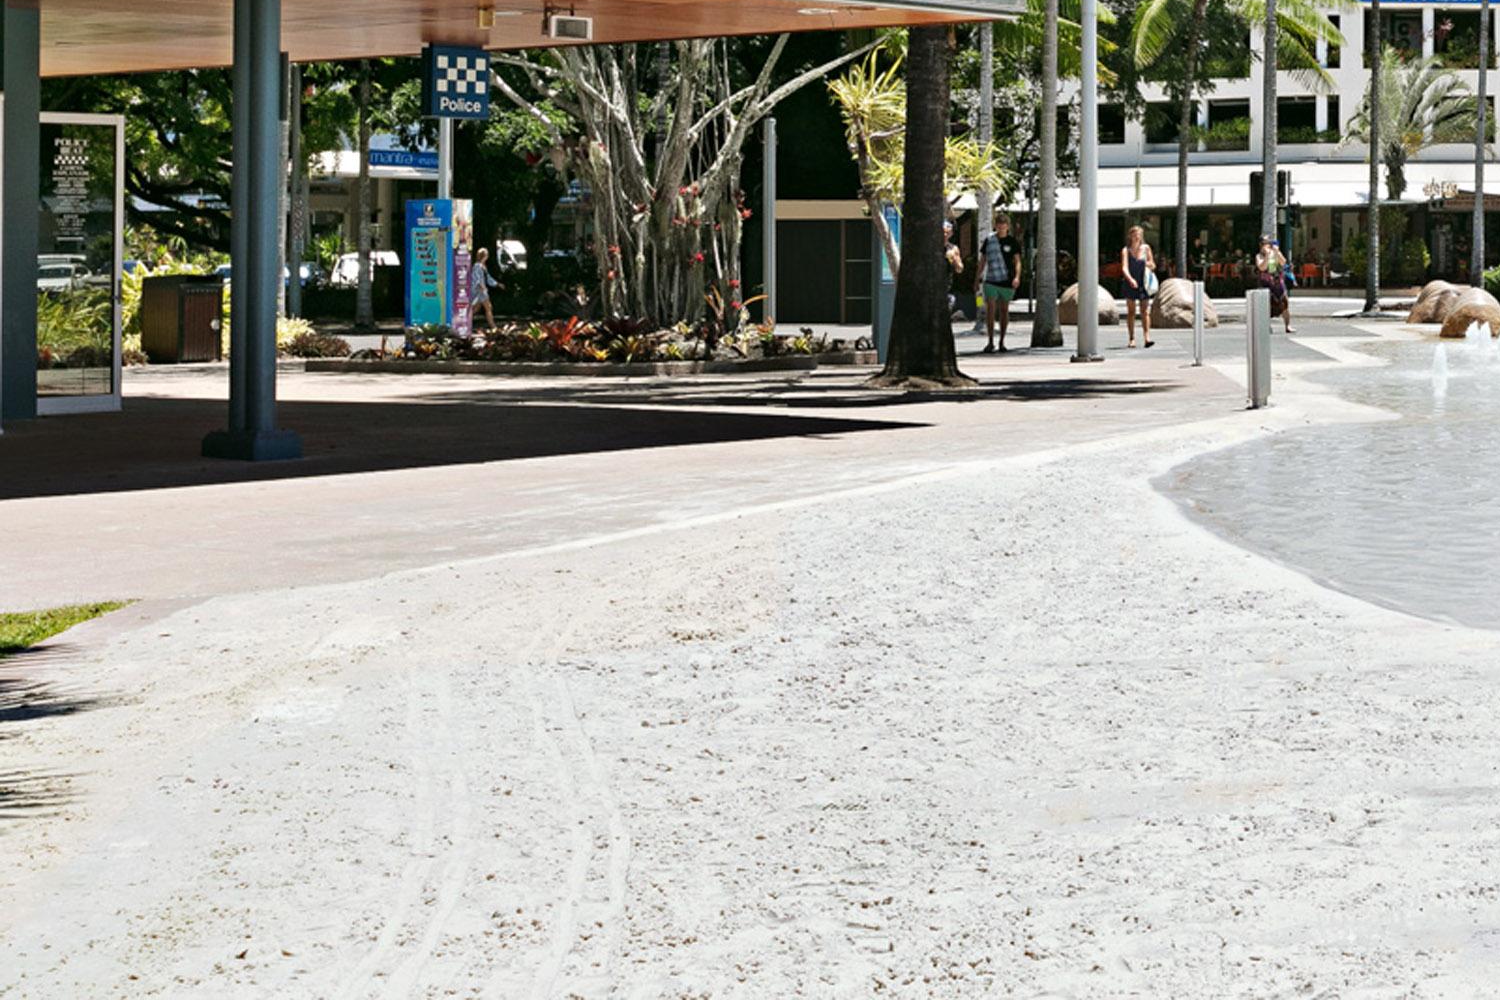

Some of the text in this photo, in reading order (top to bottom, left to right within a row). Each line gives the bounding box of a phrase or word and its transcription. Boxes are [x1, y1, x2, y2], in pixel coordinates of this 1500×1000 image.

[440, 96, 481, 112] Police
[54, 138, 89, 147] POLICE
[371, 152, 413, 164] mantra
